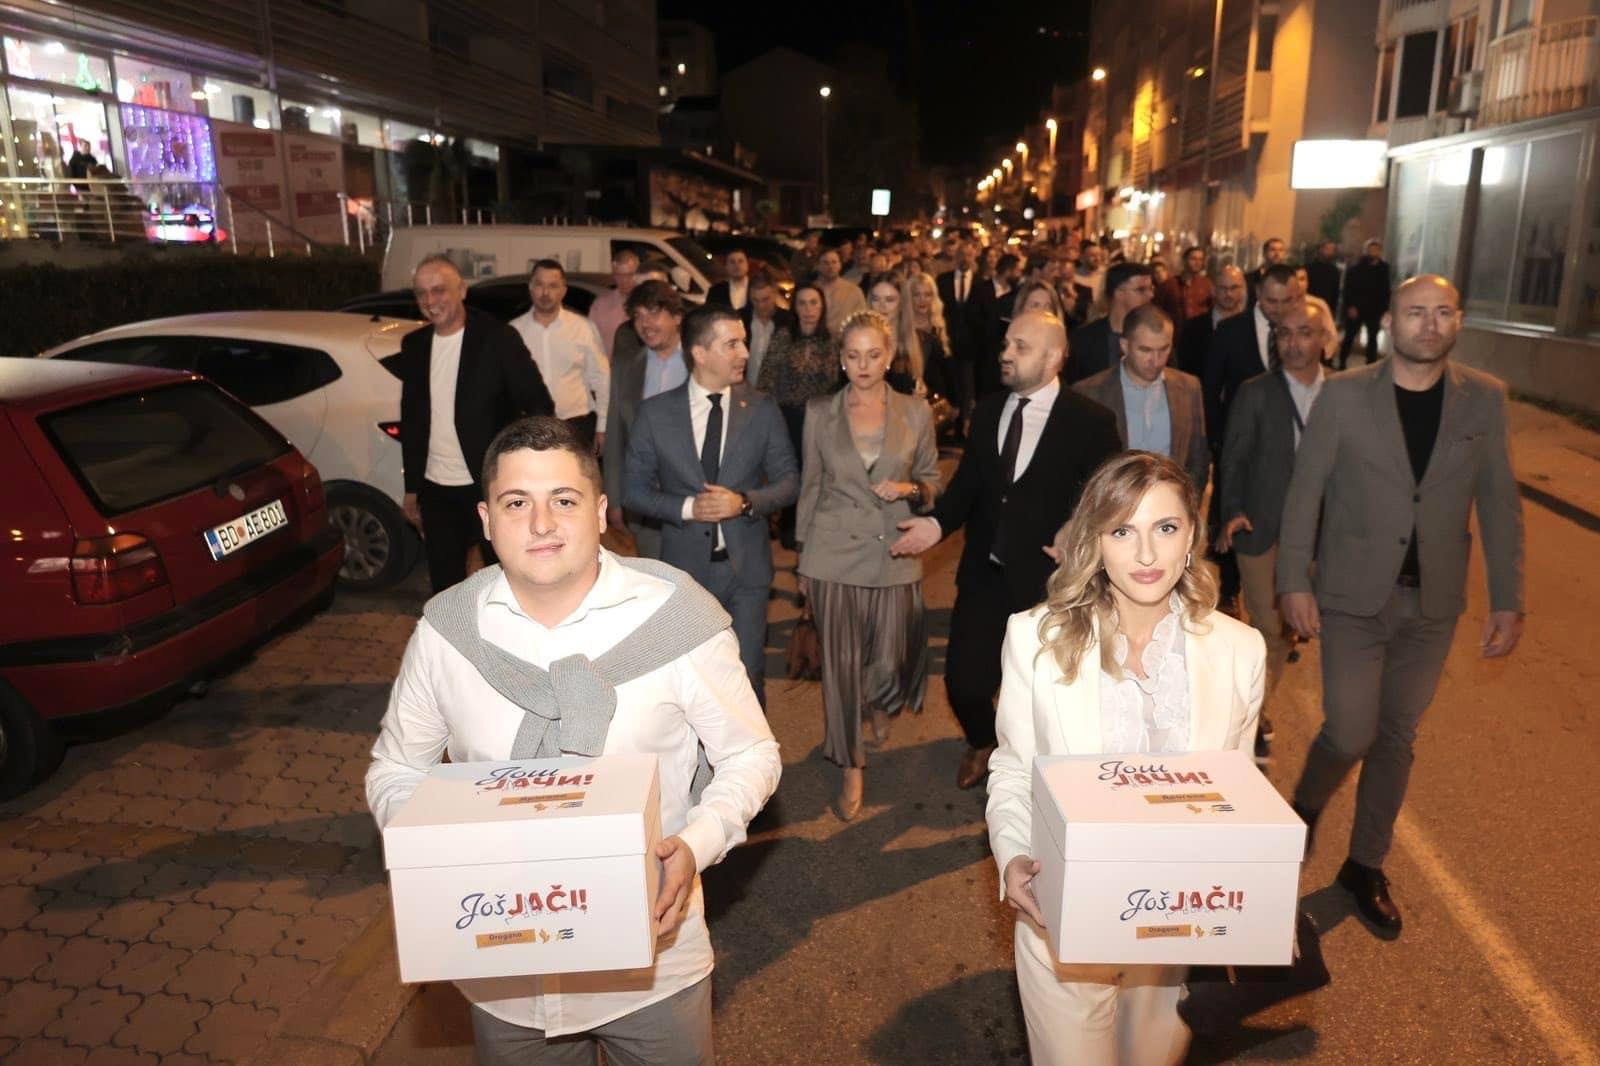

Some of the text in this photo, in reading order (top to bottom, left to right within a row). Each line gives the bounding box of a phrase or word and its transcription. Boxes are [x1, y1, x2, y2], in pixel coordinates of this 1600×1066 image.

[218, 503, 286, 550] BD AE801
[455, 885, 588, 930] Još JAČI!
[1119, 885, 1244, 921] Još JAČI!
